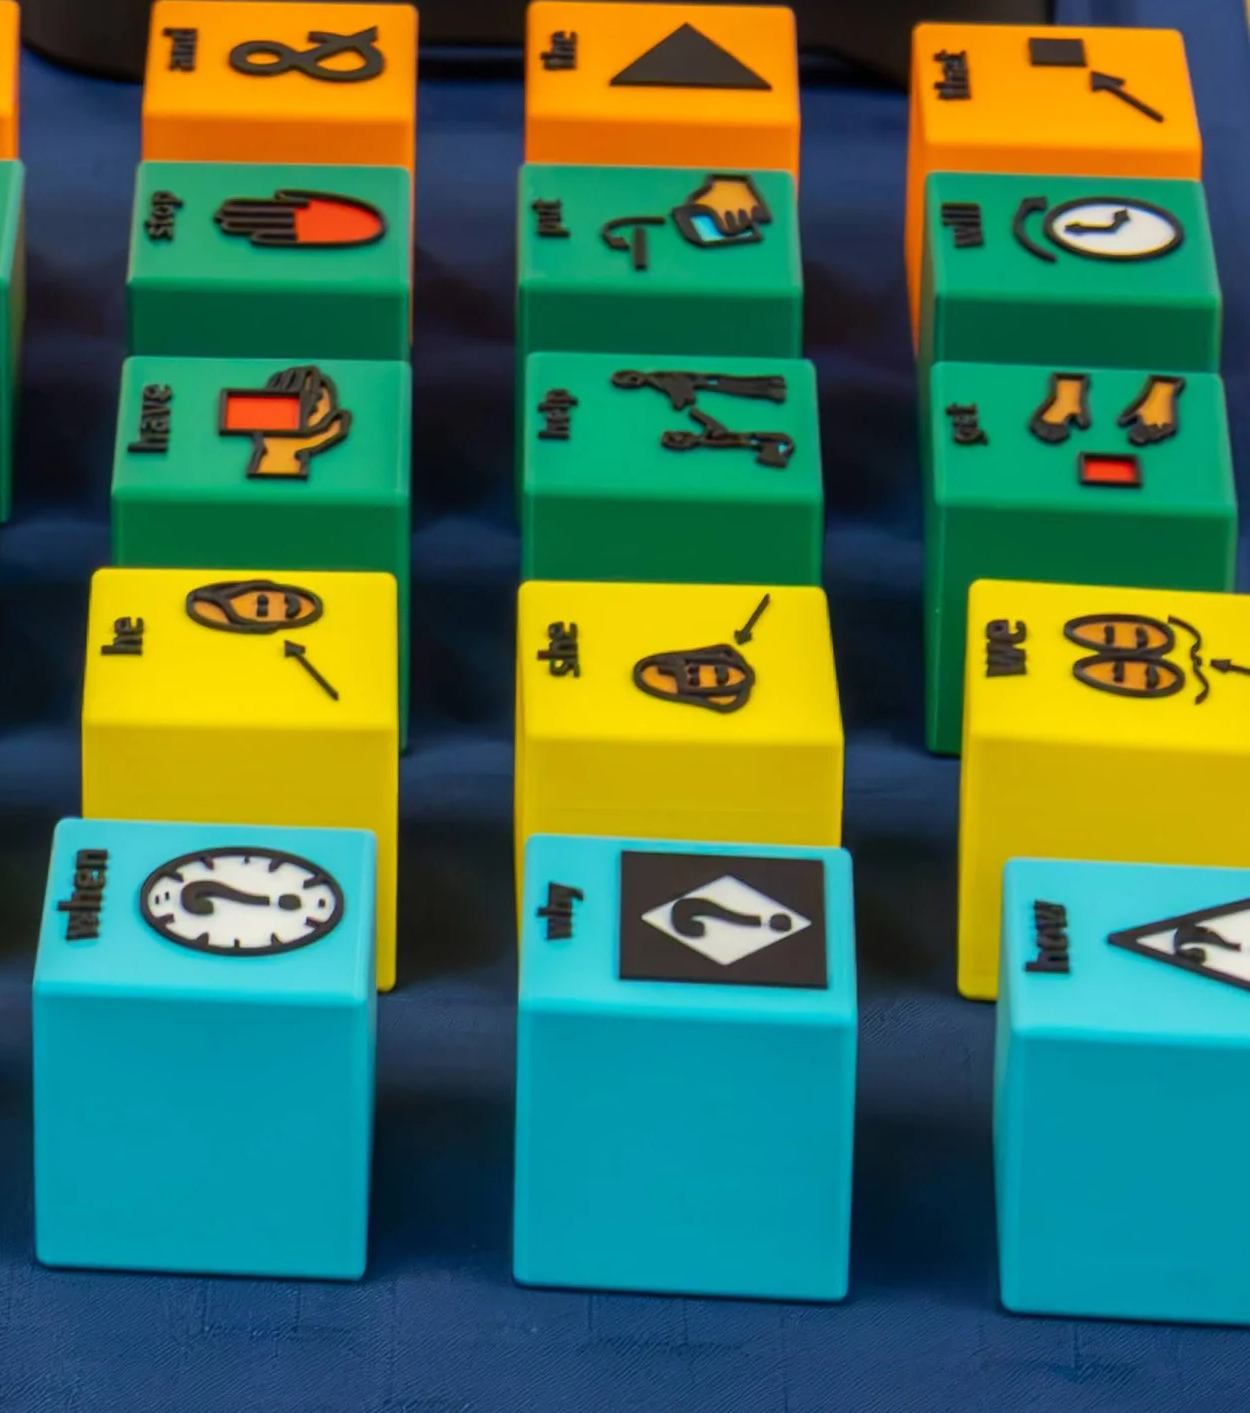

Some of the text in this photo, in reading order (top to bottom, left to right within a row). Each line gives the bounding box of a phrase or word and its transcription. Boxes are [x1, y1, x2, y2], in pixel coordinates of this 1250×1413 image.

[162, 28, 198, 73] and
[540, 30, 578, 70] the
[933, 50, 972, 101] that
[145, 190, 183, 243] stop
[532, 199, 570, 239] put
[941, 202, 984, 248] will
[128, 384, 173, 456] have
[538, 389, 578, 441] help
[945, 403, 988, 447] get
[100, 616, 144, 657] he
[537, 621, 581, 679] she
[986, 618, 1027, 678] we
[56, 848, 108, 942] when
[536, 881, 584, 941] why
[1025, 899, 1071, 975] how
